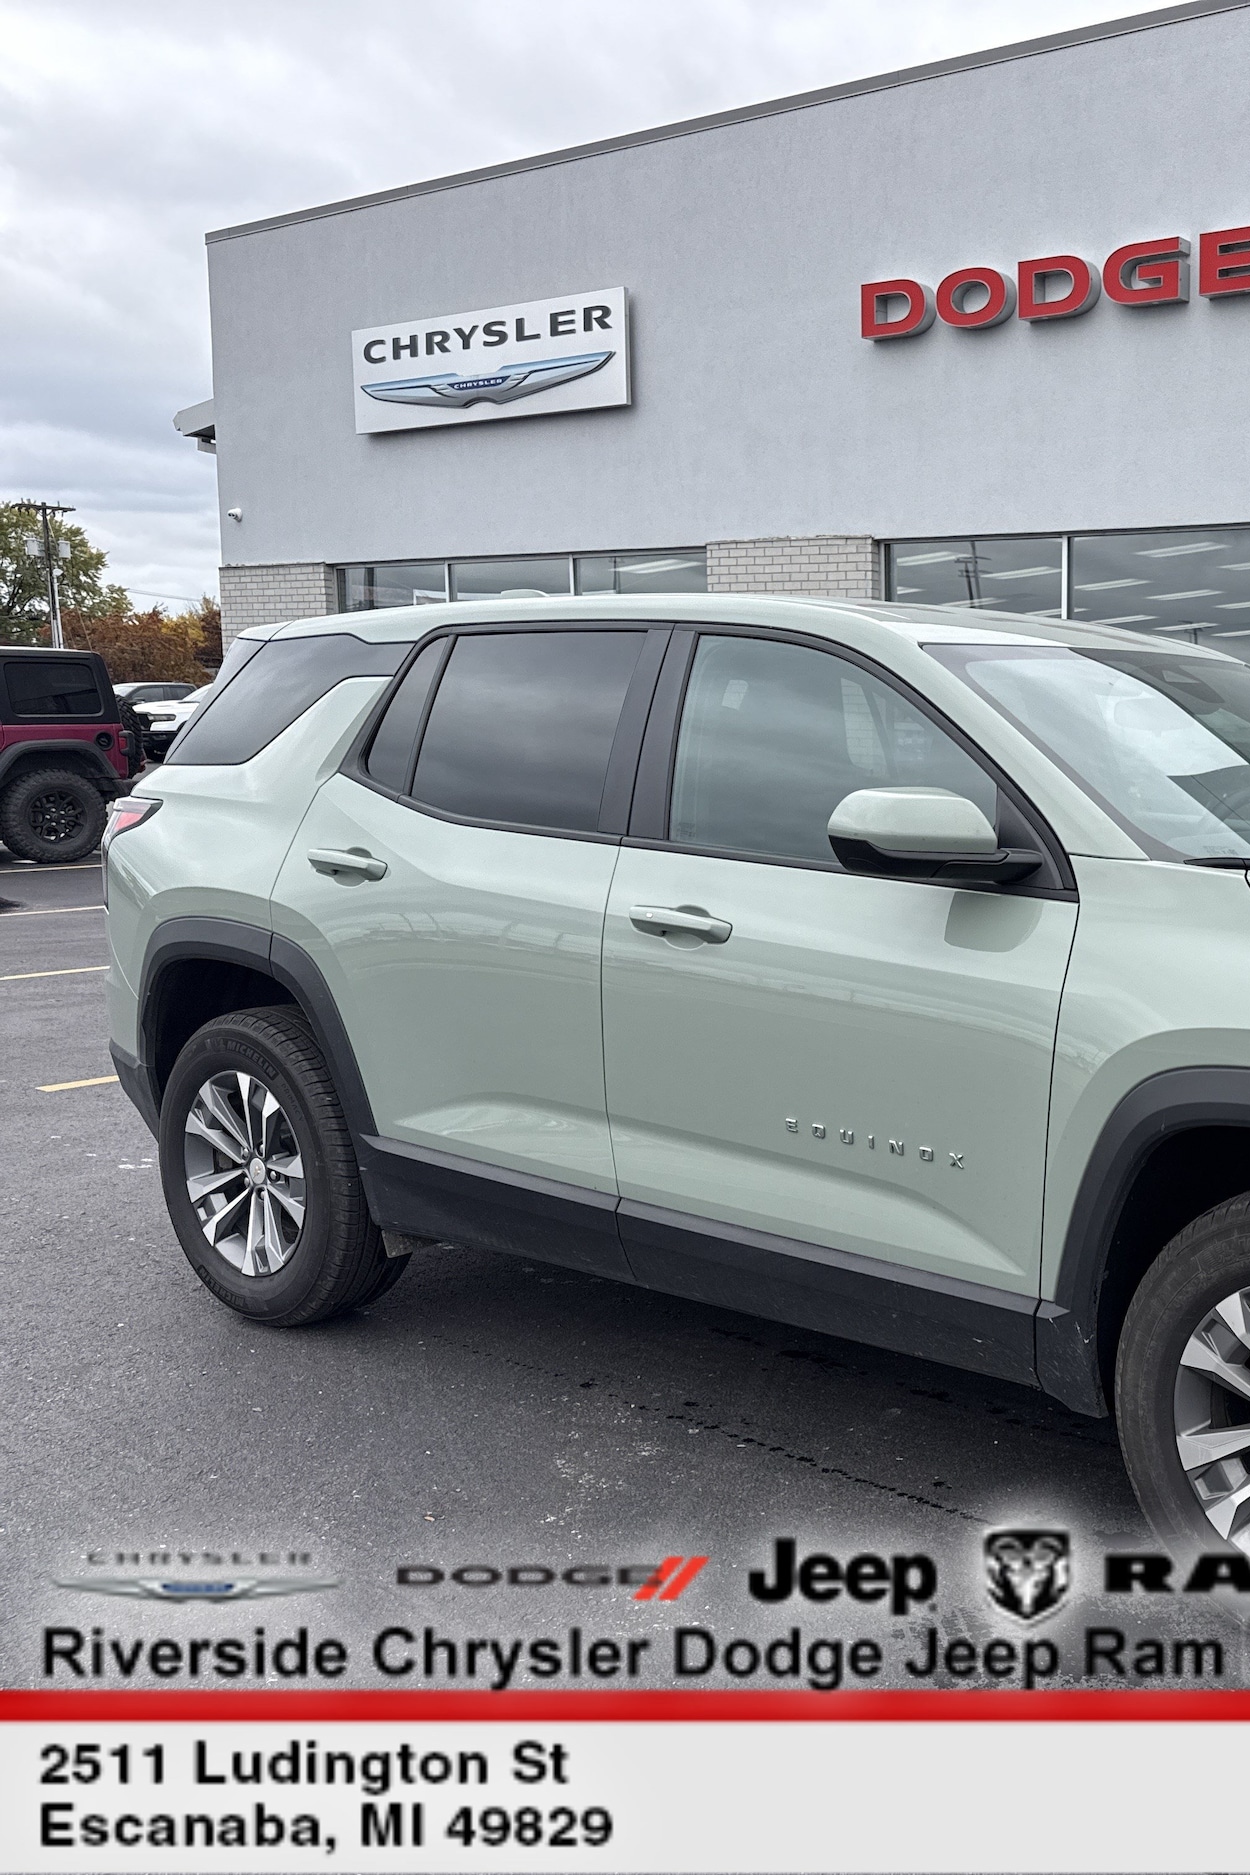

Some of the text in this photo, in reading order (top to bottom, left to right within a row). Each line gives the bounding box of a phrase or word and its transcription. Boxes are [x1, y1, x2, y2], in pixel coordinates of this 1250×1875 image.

[363, 305, 613, 364] CHRYSLER
[453, 378, 503, 390] CHRYSLER
[226, 1041, 277, 1078] MICHELIN
[785, 1117, 965, 1169] EQUINOX
